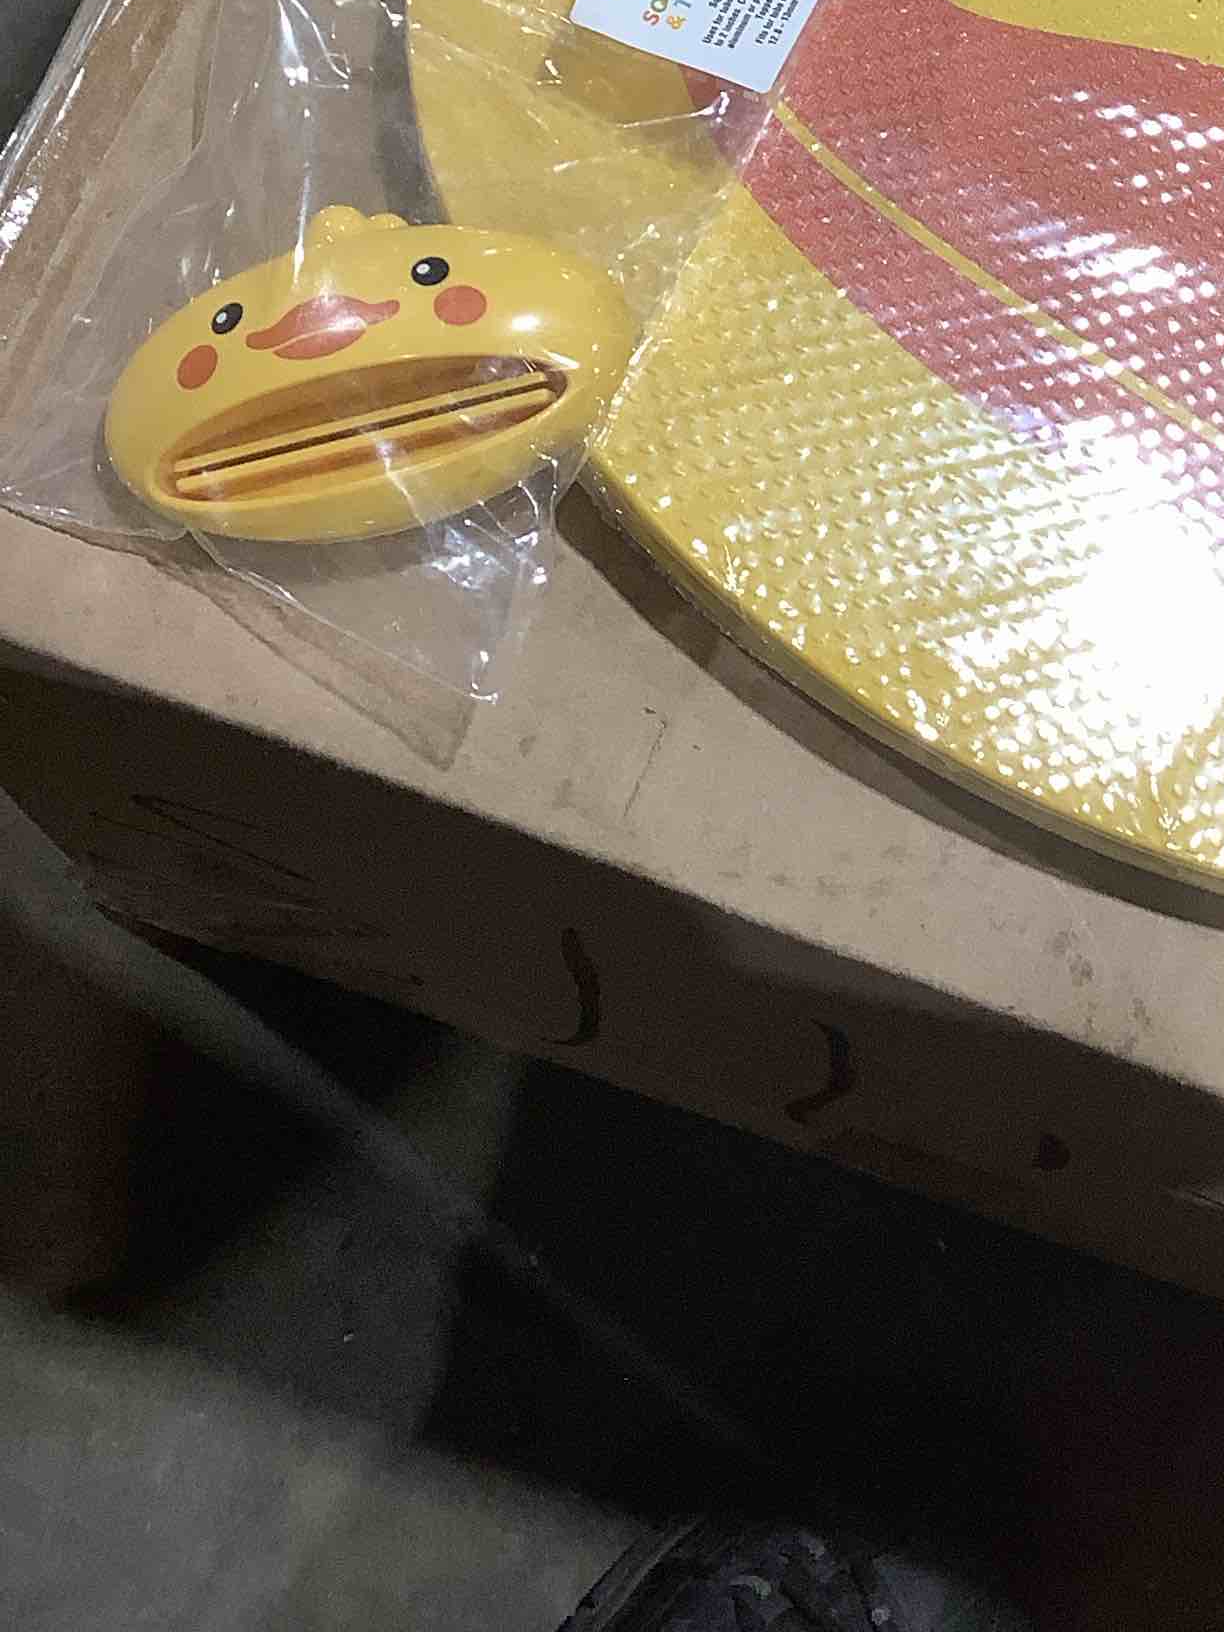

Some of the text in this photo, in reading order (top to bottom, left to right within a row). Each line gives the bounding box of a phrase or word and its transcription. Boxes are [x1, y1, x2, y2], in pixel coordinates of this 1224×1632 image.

[667, 15, 686, 29] &
[713, 14, 724, 25] for
[763, 18, 774, 29] for
[769, 2, 784, 18] tube
